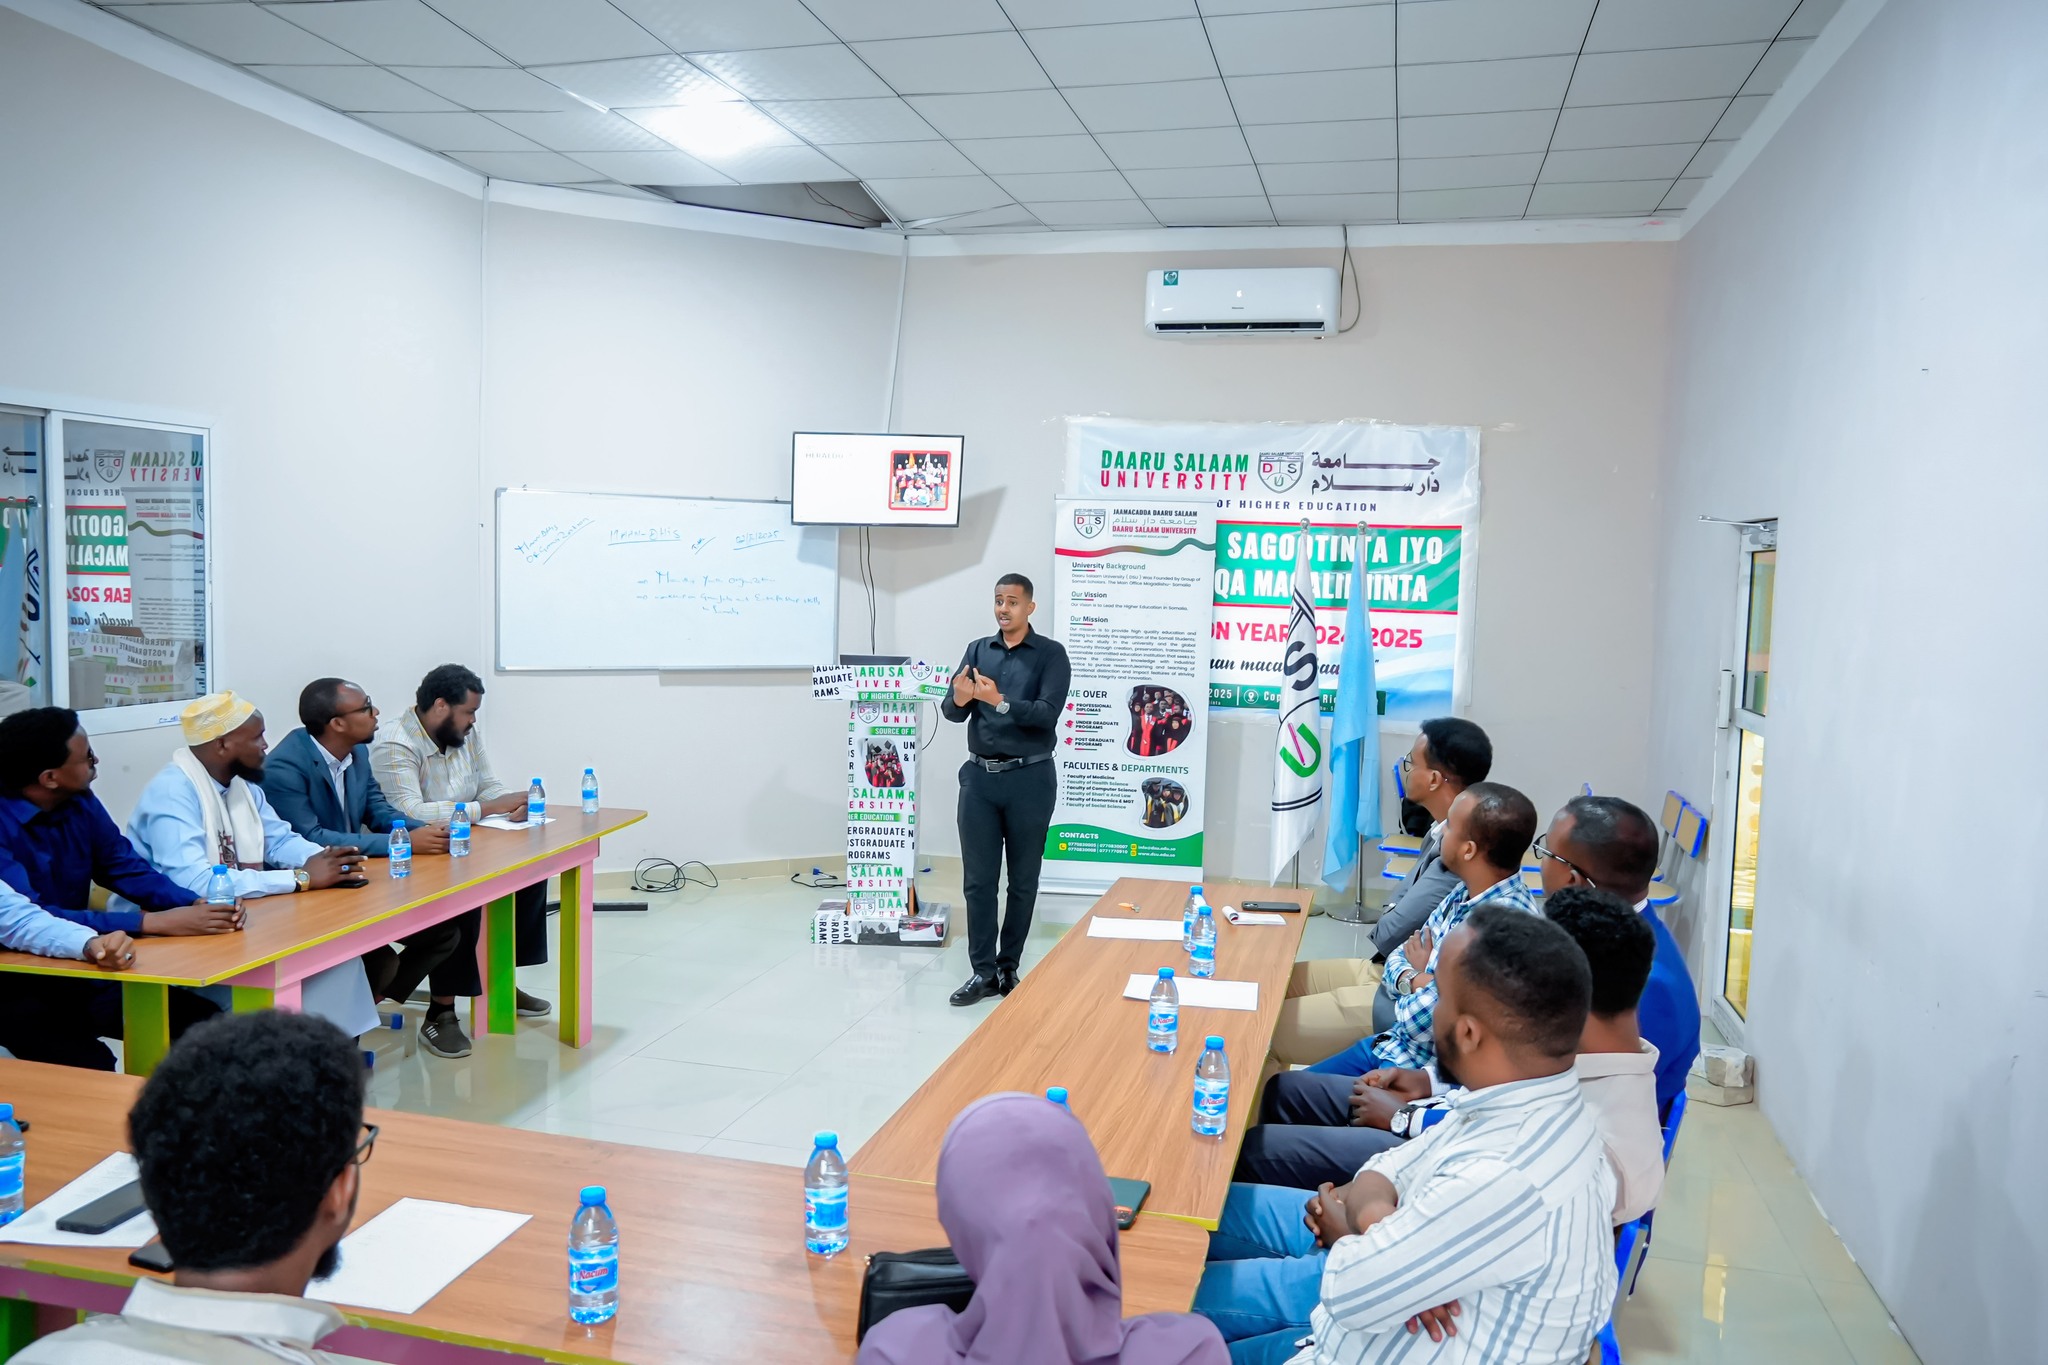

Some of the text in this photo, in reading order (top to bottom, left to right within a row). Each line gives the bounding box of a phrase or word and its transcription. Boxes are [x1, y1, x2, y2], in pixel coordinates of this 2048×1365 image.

[1101, 450, 1165, 470] DAARU
[1174, 452, 1249, 473] SALAAM
[1311, 451, 1440, 474] جامعة
[1262, 463, 1273, 473] D
[1287, 463, 1297, 474] S
[1101, 470, 1247, 491] UNIVERSITY
[1274, 476, 1284, 487] U
[1312, 474, 1413, 495] سلام
[1239, 500, 1290, 510] HIGHER
[1299, 501, 1377, 512] EDUCATION
[1077, 516, 1084, 524] D
[1094, 516, 1101, 524] S
[1086, 526, 1092, 534] U
[1112, 525, 1133, 533] DAARU
[1400, 536, 1443, 564] IYO
[1072, 562, 1104, 570] University
[1214, 569, 1246, 599] QA
[1237, 622, 1289, 642] YEAR
[1371, 628, 1422, 648] 2025
[871, 692, 894, 700] HIGHER
[1083, 690, 1108, 699] OVER
[1063, 762, 1110, 770] FACULTIES
[1121, 764, 1189, 774] DEPARTMENTS
[853, 788, 904, 799] SALAAM
[849, 801, 904, 809] ERSITY
[848, 827, 905, 836] ERGRADUATE
[848, 851, 891, 859] ROGRAMS
[851, 867, 903, 878] SALAAM
[848, 880, 903, 888] ERSITY
